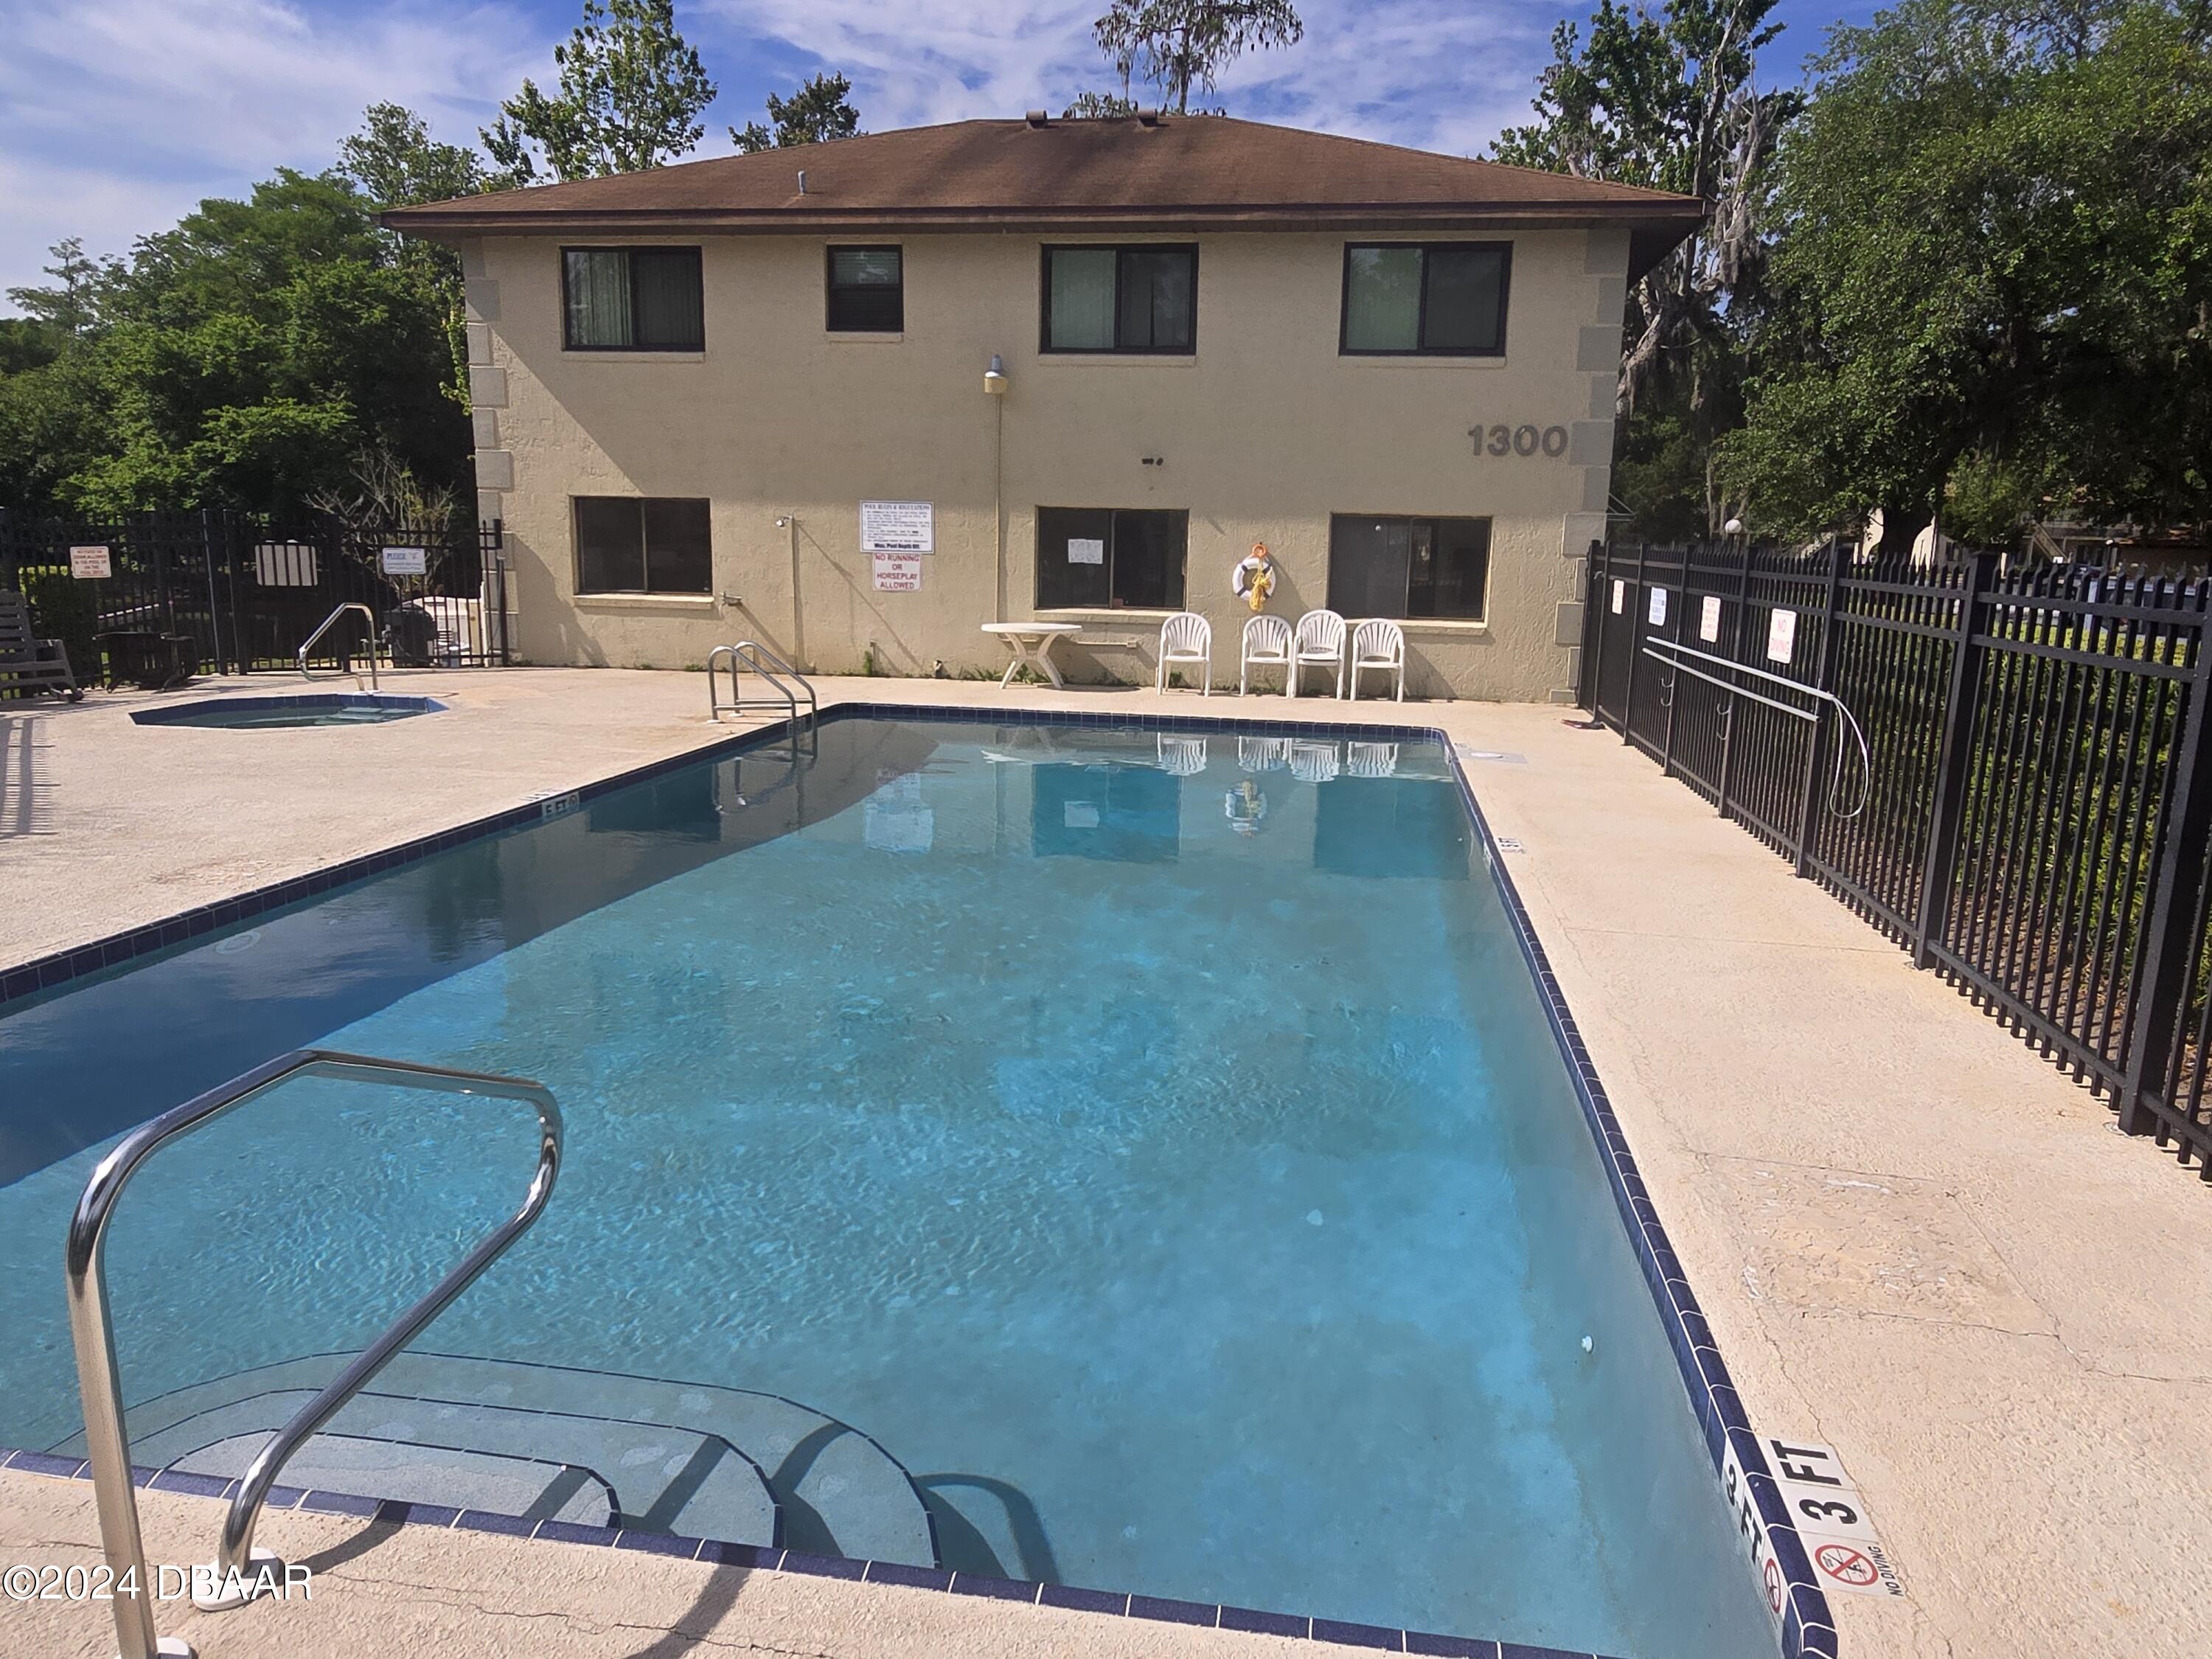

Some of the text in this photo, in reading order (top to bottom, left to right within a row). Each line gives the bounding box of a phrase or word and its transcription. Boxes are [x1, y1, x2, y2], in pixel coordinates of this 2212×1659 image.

[1467, 425, 1568, 458] 1300
[1777, 619, 1787, 633] NO
[1770, 1439, 1858, 1525] 3 FT
[1726, 1464, 1762, 1565] 3 FT
[1868, 1545, 1905, 1597] NO DIVING
